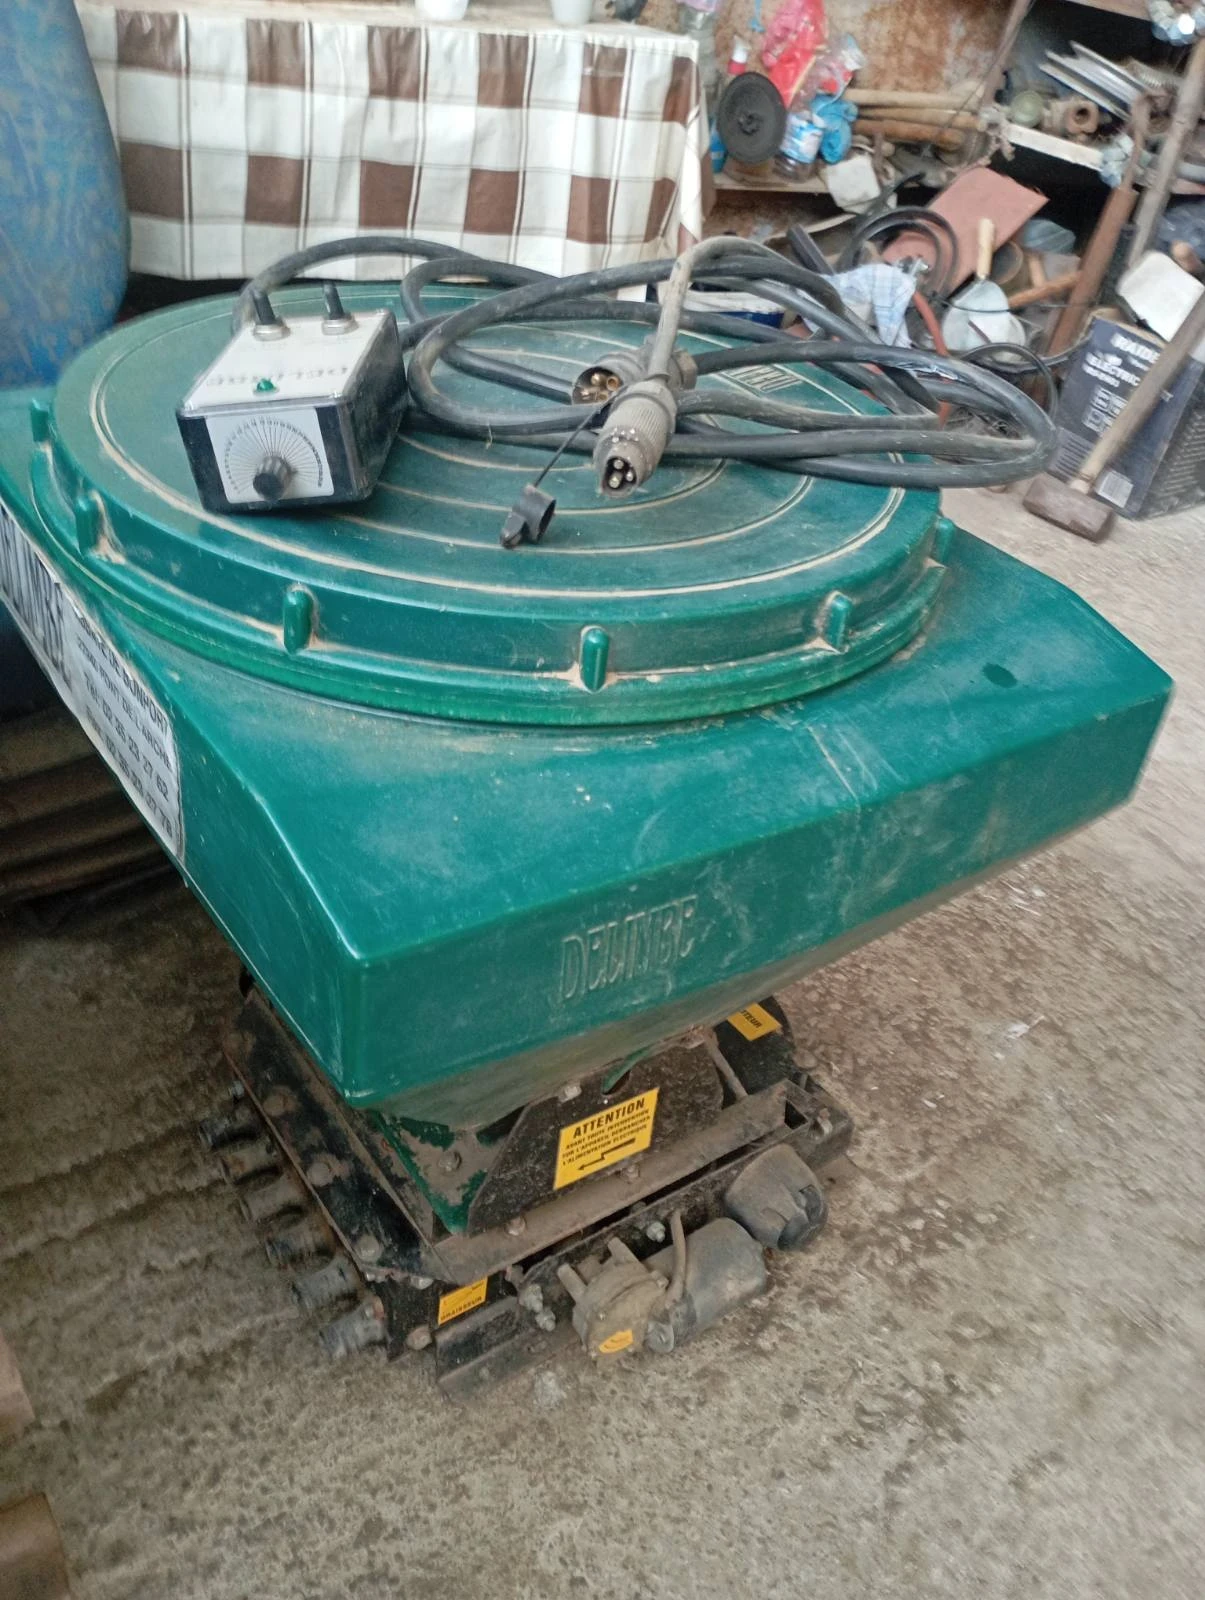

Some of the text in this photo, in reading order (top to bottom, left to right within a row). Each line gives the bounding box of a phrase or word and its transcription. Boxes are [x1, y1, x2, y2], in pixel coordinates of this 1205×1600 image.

[1110, 333, 1161, 364] RAIDE
[566, 1108, 649, 1149] AVANT TOUTE INTERVENTION
[573, 1097, 645, 1139] ATTENTION
[562, 1140, 611, 1166] L'ALIMENTATION
[576, 1134, 610, 1153] L'APPAREIL
